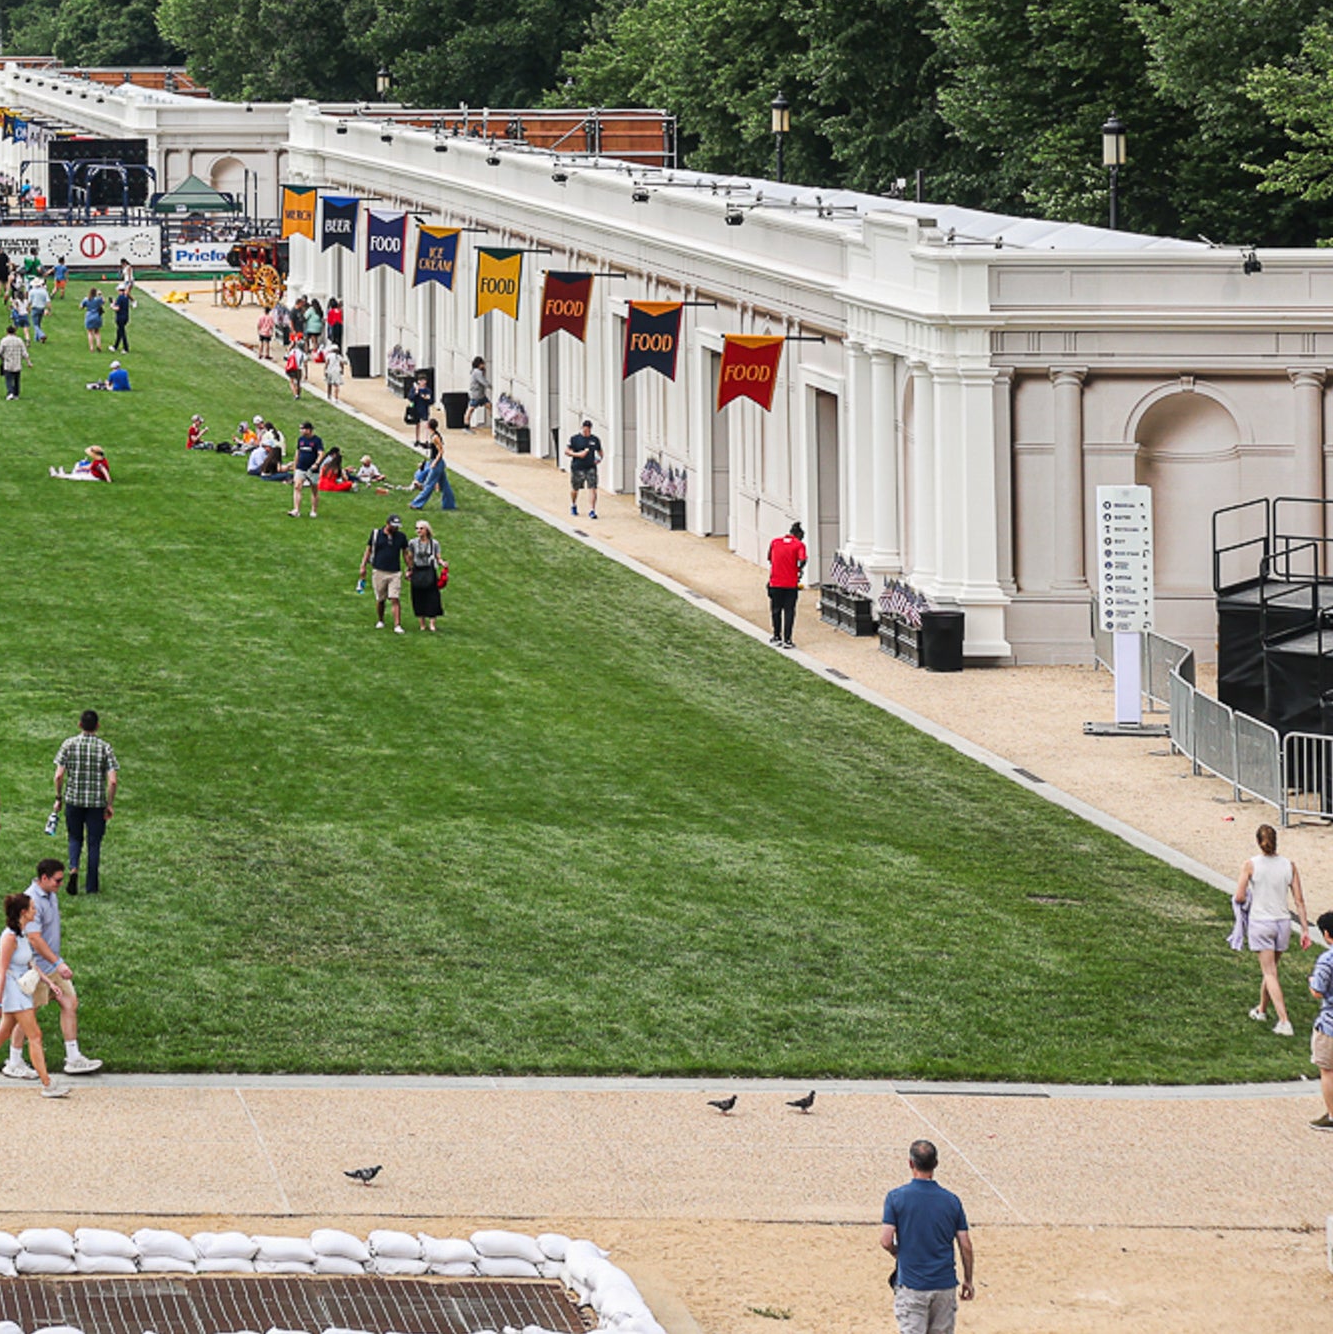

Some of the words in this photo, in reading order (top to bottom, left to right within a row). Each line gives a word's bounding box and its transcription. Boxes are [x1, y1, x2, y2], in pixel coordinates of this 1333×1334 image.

[285, 209, 312, 221] MERCH
[324, 219, 352, 234] BEER
[370, 236, 401, 253] FOOD
[429, 247, 444, 259] ICE
[419, 258, 452, 273] CREAM
[480, 277, 516, 295] FOOD
[545, 299, 584, 317] FOOD
[630, 333, 672, 352] FOOD
[724, 363, 770, 383] FOOD
